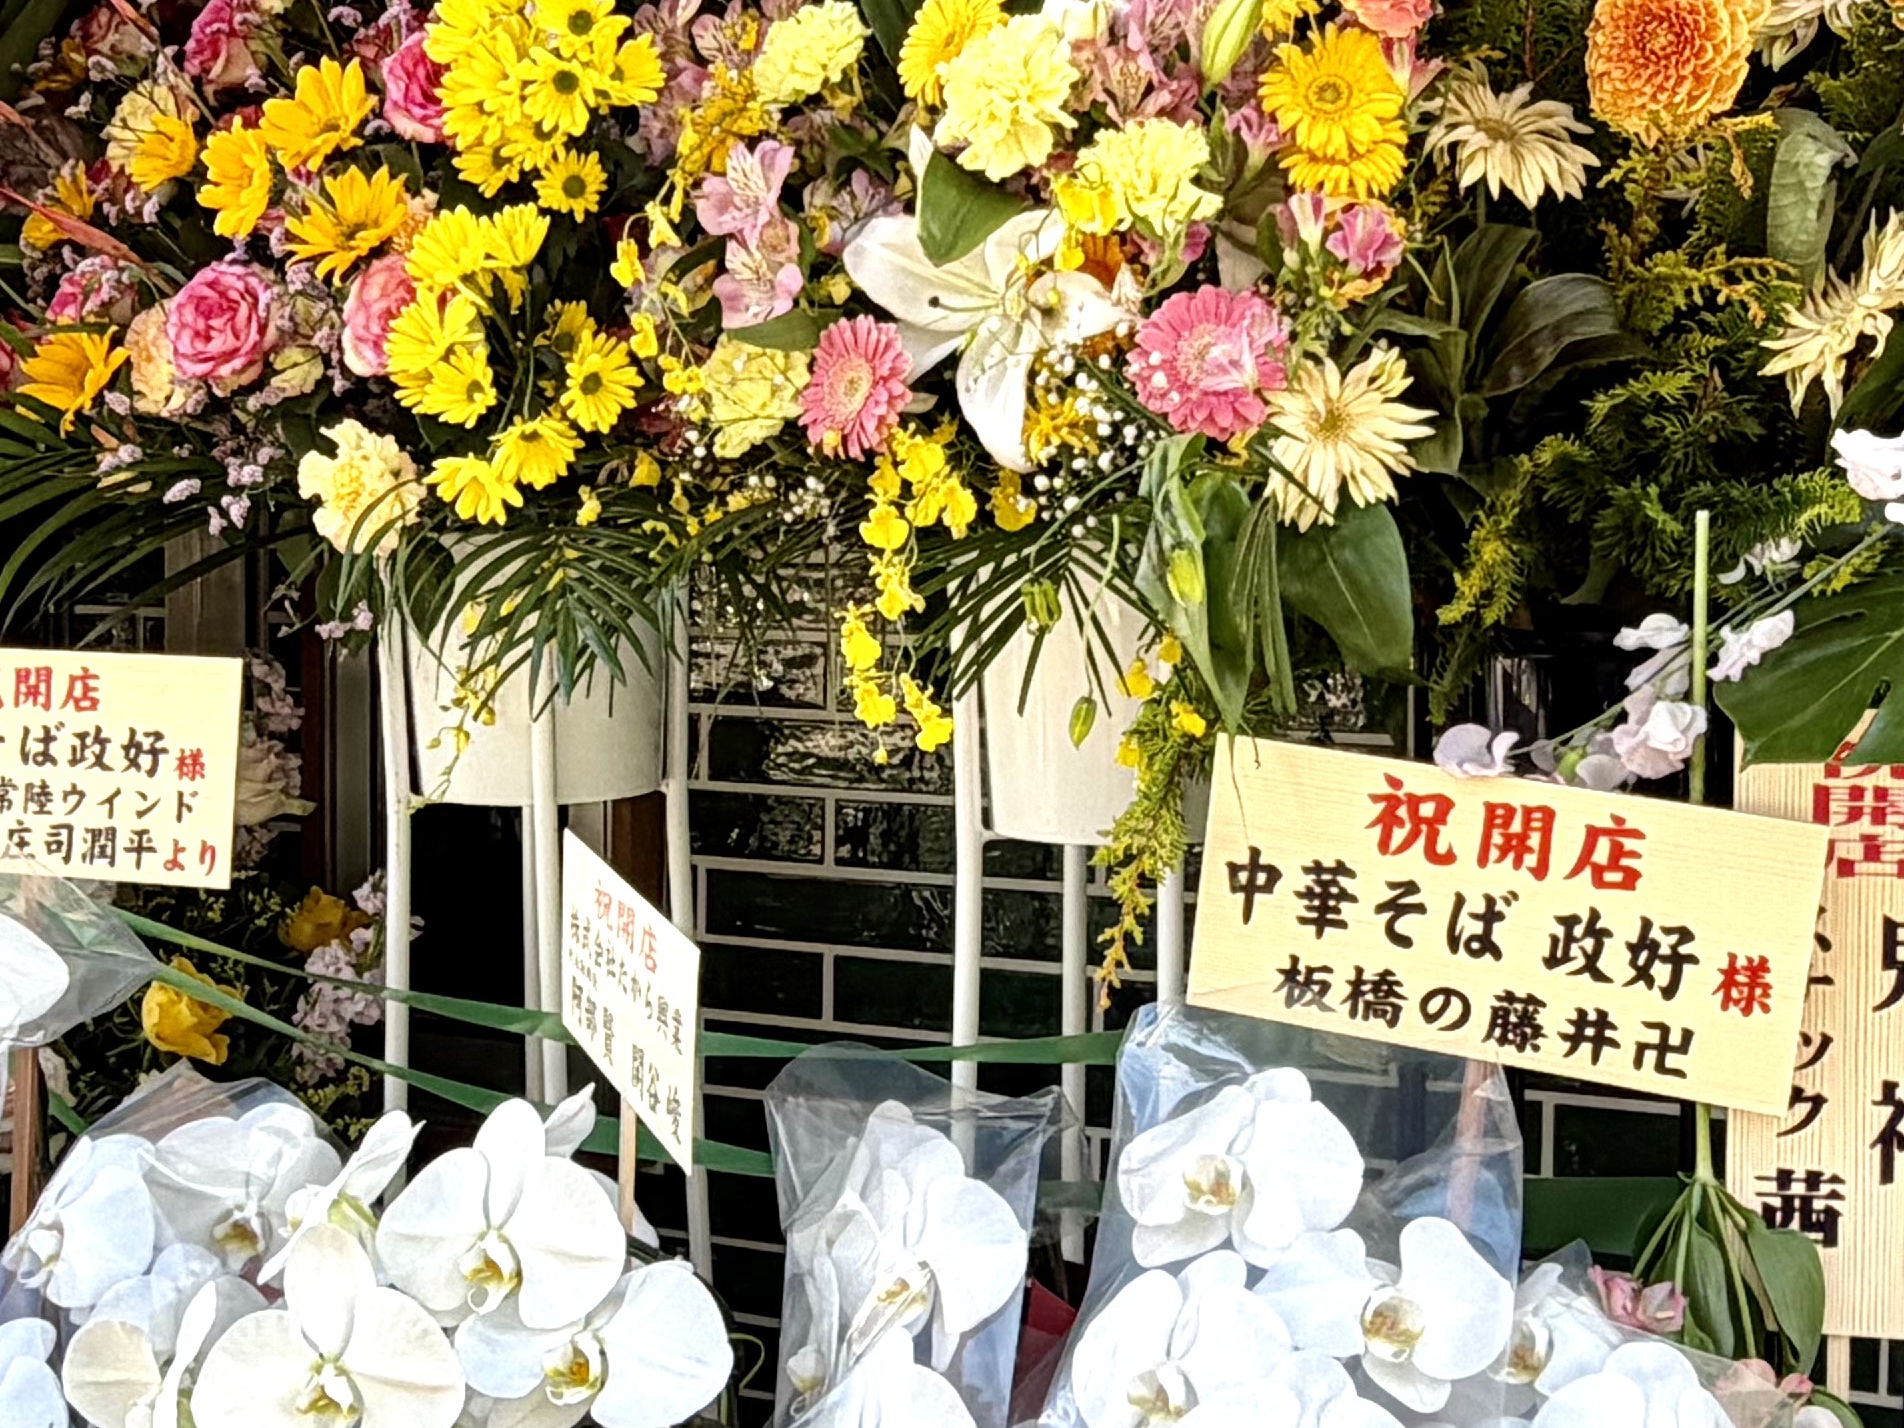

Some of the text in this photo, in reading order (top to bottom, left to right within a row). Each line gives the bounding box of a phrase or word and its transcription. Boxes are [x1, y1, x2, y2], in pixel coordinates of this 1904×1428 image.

[1363, 772, 1649, 892] 祝開店
[594, 878, 658, 975] 祝開店
